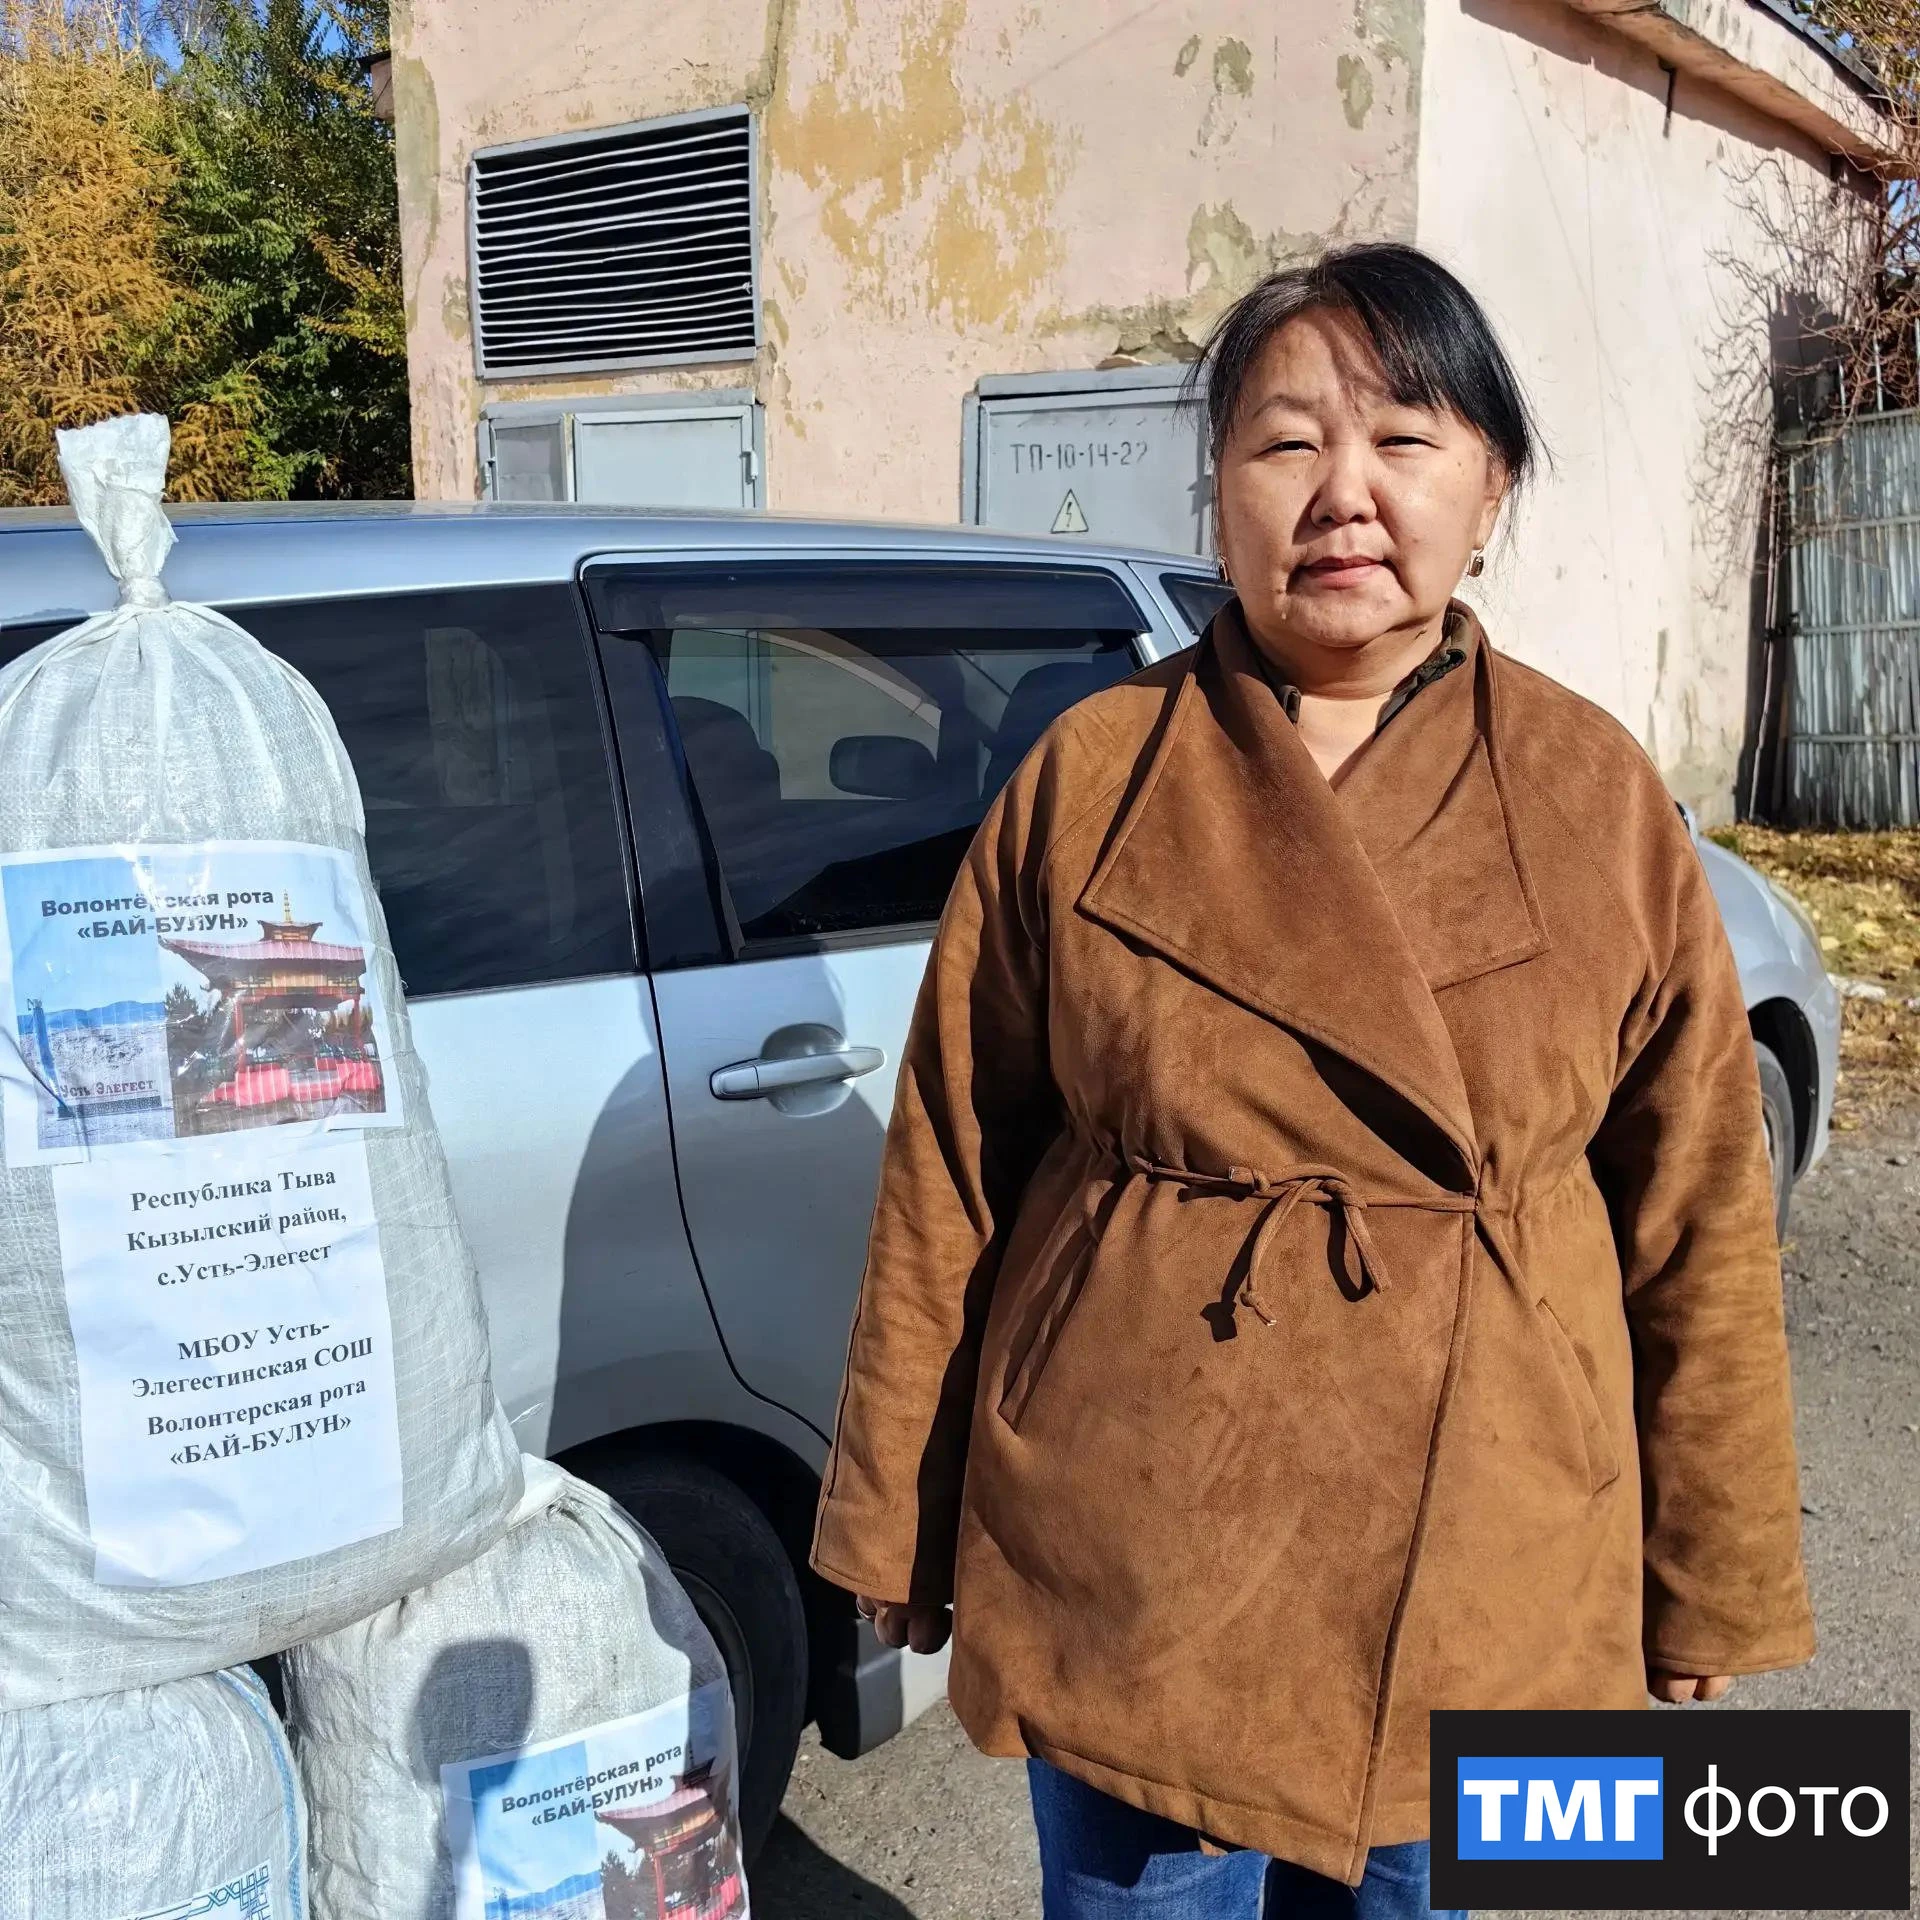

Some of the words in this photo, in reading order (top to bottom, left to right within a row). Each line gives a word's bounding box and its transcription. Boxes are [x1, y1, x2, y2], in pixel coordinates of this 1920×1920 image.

[227, 891, 274, 908] рота
[77, 913, 249, 939] «БАЙ-БУЛУН»
[131, 1179, 273, 1212] Республика
[278, 1169, 336, 1192] Тыва
[127, 1214, 273, 1252] Кызылский
[278, 1207, 347, 1234] район,
[157, 1243, 332, 1286] с.Усть-Элегест
[177, 1330, 259, 1360] МБОУ
[266, 1322, 330, 1346] Усть-
[132, 1358, 308, 1398] Элегестинская
[314, 1337, 374, 1368] СОШ
[147, 1392, 313, 1436] Волонтерская
[319, 1379, 367, 1408] рота
[169, 1413, 353, 1466] «БАЙ-БУЛУН»
[501, 1760, 640, 1813] Волонтёрская
[645, 1745, 682, 1773] рота
[531, 1775, 664, 1826] «БАЙ-БУЛУН»
